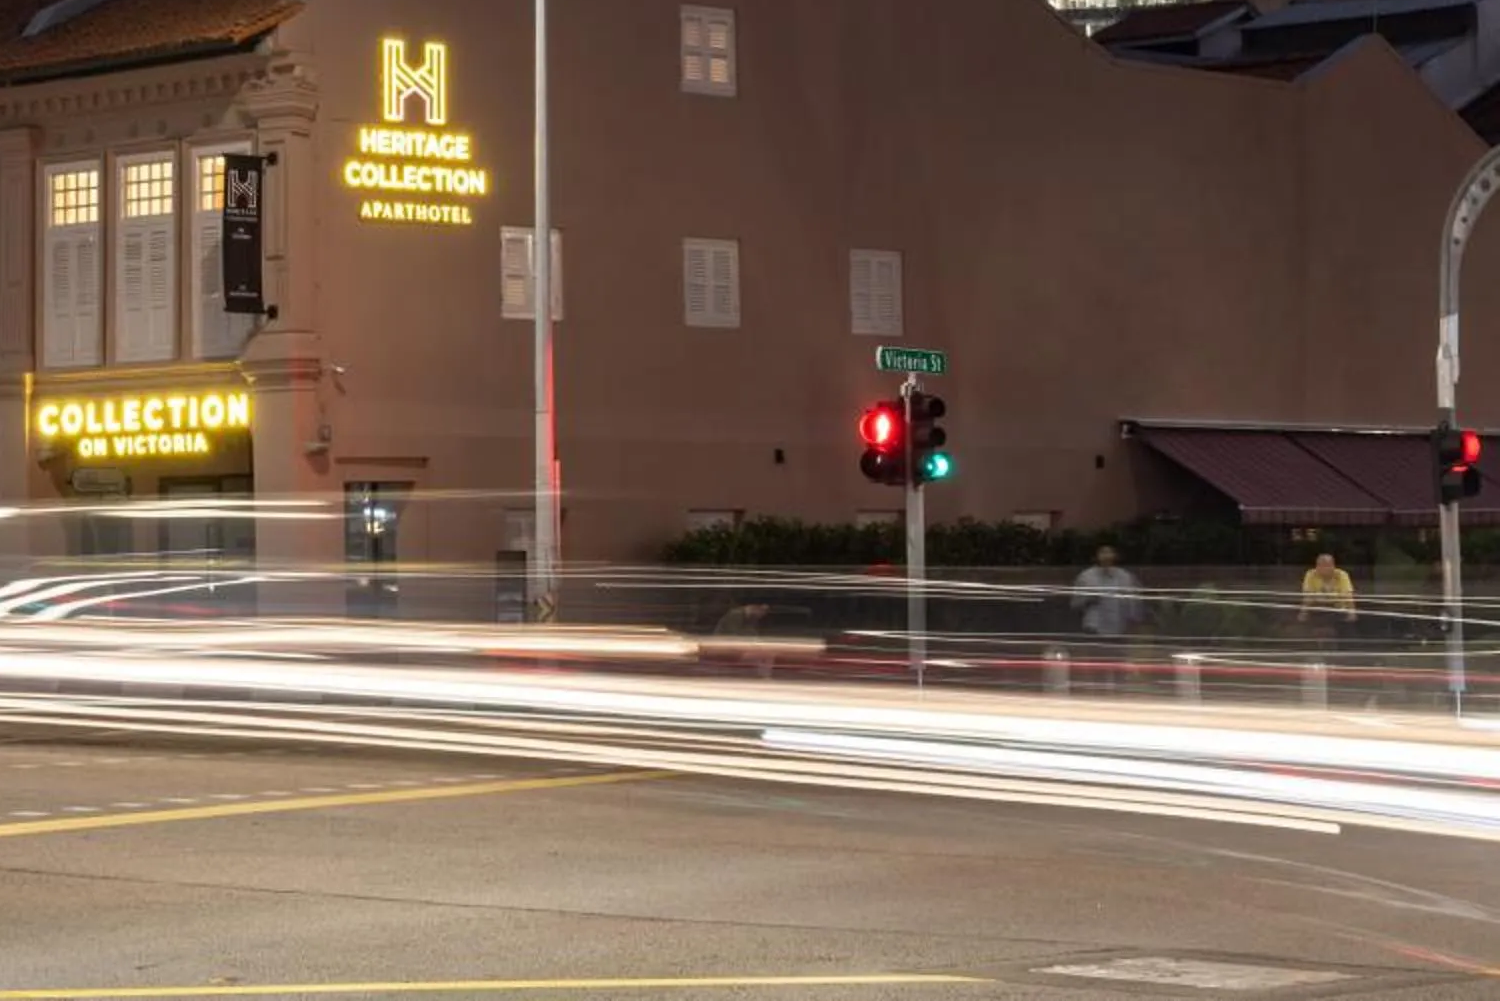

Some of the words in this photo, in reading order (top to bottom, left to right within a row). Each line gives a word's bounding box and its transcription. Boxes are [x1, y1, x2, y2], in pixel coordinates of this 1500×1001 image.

[359, 128, 470, 160] HERITAGE
[344, 161, 486, 195] COLLECTION
[361, 201, 472, 225] APARTHOTEL
[885, 351, 928, 370] Victoria
[931, 354, 941, 372] St
[39, 393, 250, 435] COLLECTION
[78, 438, 107, 457] ON
[114, 433, 208, 456] VICTORIA
